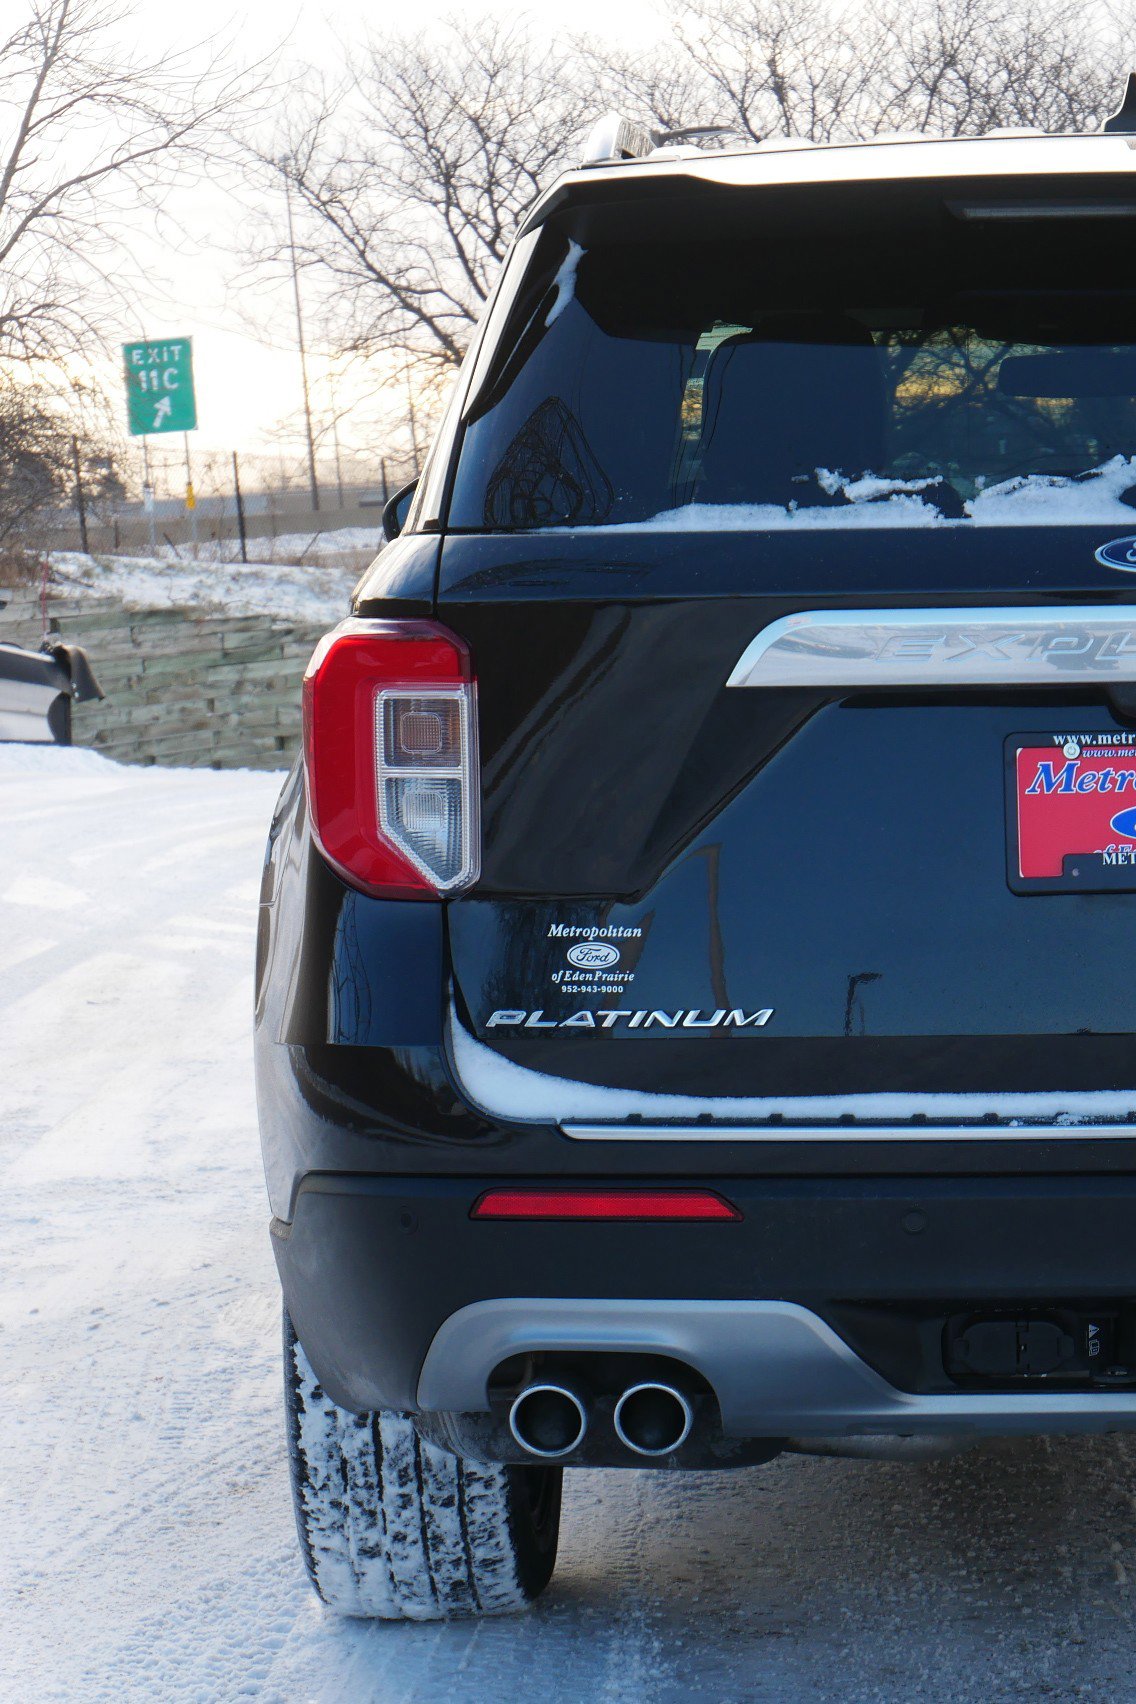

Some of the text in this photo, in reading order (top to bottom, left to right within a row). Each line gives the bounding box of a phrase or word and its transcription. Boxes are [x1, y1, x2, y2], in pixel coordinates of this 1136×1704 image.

[132, 345, 182, 365] EXIT
[139, 367, 179, 392] 11C
[547, 923, 642, 941] Metropolitan
[576, 947, 611, 962] Ford
[551, 970, 635, 983] of Eden Prairie
[561, 985, 624, 993] 952-943-9000
[485, 1008, 775, 1028] PLATINUM
